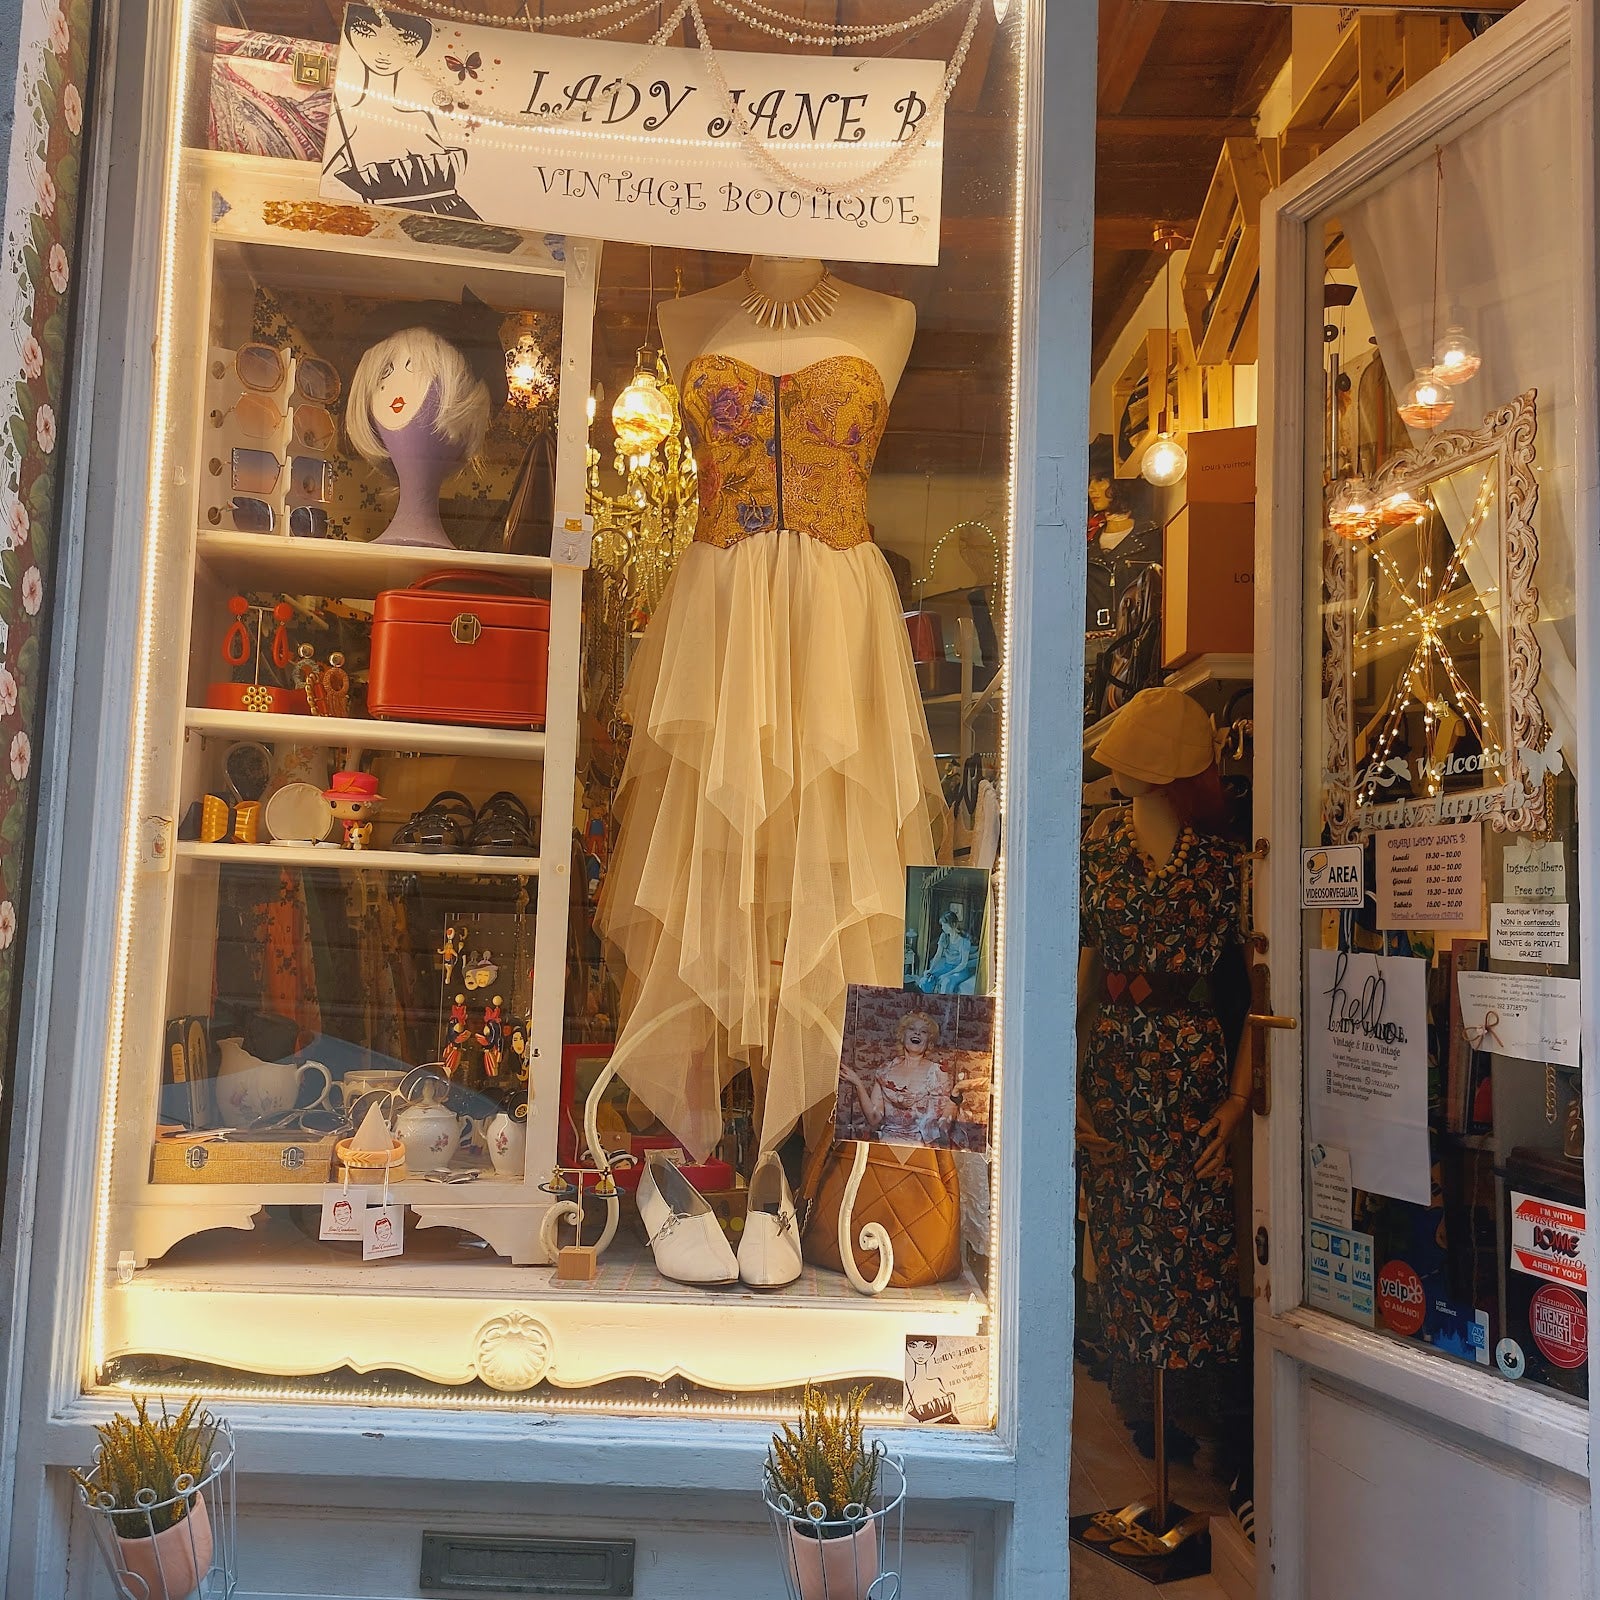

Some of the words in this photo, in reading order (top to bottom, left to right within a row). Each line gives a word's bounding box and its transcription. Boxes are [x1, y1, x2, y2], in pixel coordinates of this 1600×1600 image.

[520, 70, 698, 132] LADY
[707, 89, 868, 143] JANE
[532, 165, 706, 216] VINTAGE
[1223, 461, 1251, 469] VUITTON
[1416, 749, 1513, 780] Welcome
[1413, 836, 1434, 848] LADY
[1435, 834, 1458, 846] JANE
[1328, 866, 1358, 883] AREA
[1506, 863, 1539, 875] Ingresso
[1541, 861, 1564, 873] libero
[1305, 886, 1359, 899] VIDEOSORVEGLIATA
[1514, 885, 1532, 895] Free
[1535, 886, 1556, 897] entry
[1506, 908, 1531, 917] Boutique
[1532, 908, 1555, 916] Vintage
[1519, 950, 1542, 958] GRAZIE
[1332, 1036, 1355, 1053] Vintage
[1376, 1044, 1401, 1061] Vintage
[1515, 1211, 1561, 1230] Acoustic
[1539, 1207, 1551, 1217] I'M
[1552, 1210, 1573, 1223] WITH
[1533, 1225, 1581, 1258] BOWIE
[1313, 1257, 1329, 1270] VISA
[1532, 1260, 1560, 1274] AREN'T
[1561, 1267, 1583, 1281] YOU?
[1355, 1269, 1372, 1283] VISA
[1380, 1278, 1410, 1303] yelp
[1435, 1300, 1447, 1308] LOVE
[1435, 1305, 1457, 1317] FLORENCE
[1537, 1295, 1575, 1313] SELEZIONATO
[1575, 1306, 1584, 1315] DA
[1535, 1304, 1570, 1328] FIRENZE
[933, 1351, 956, 1365] LADY
[958, 1345, 977, 1357] JANE
[951, 1361, 974, 1370] Vintage
